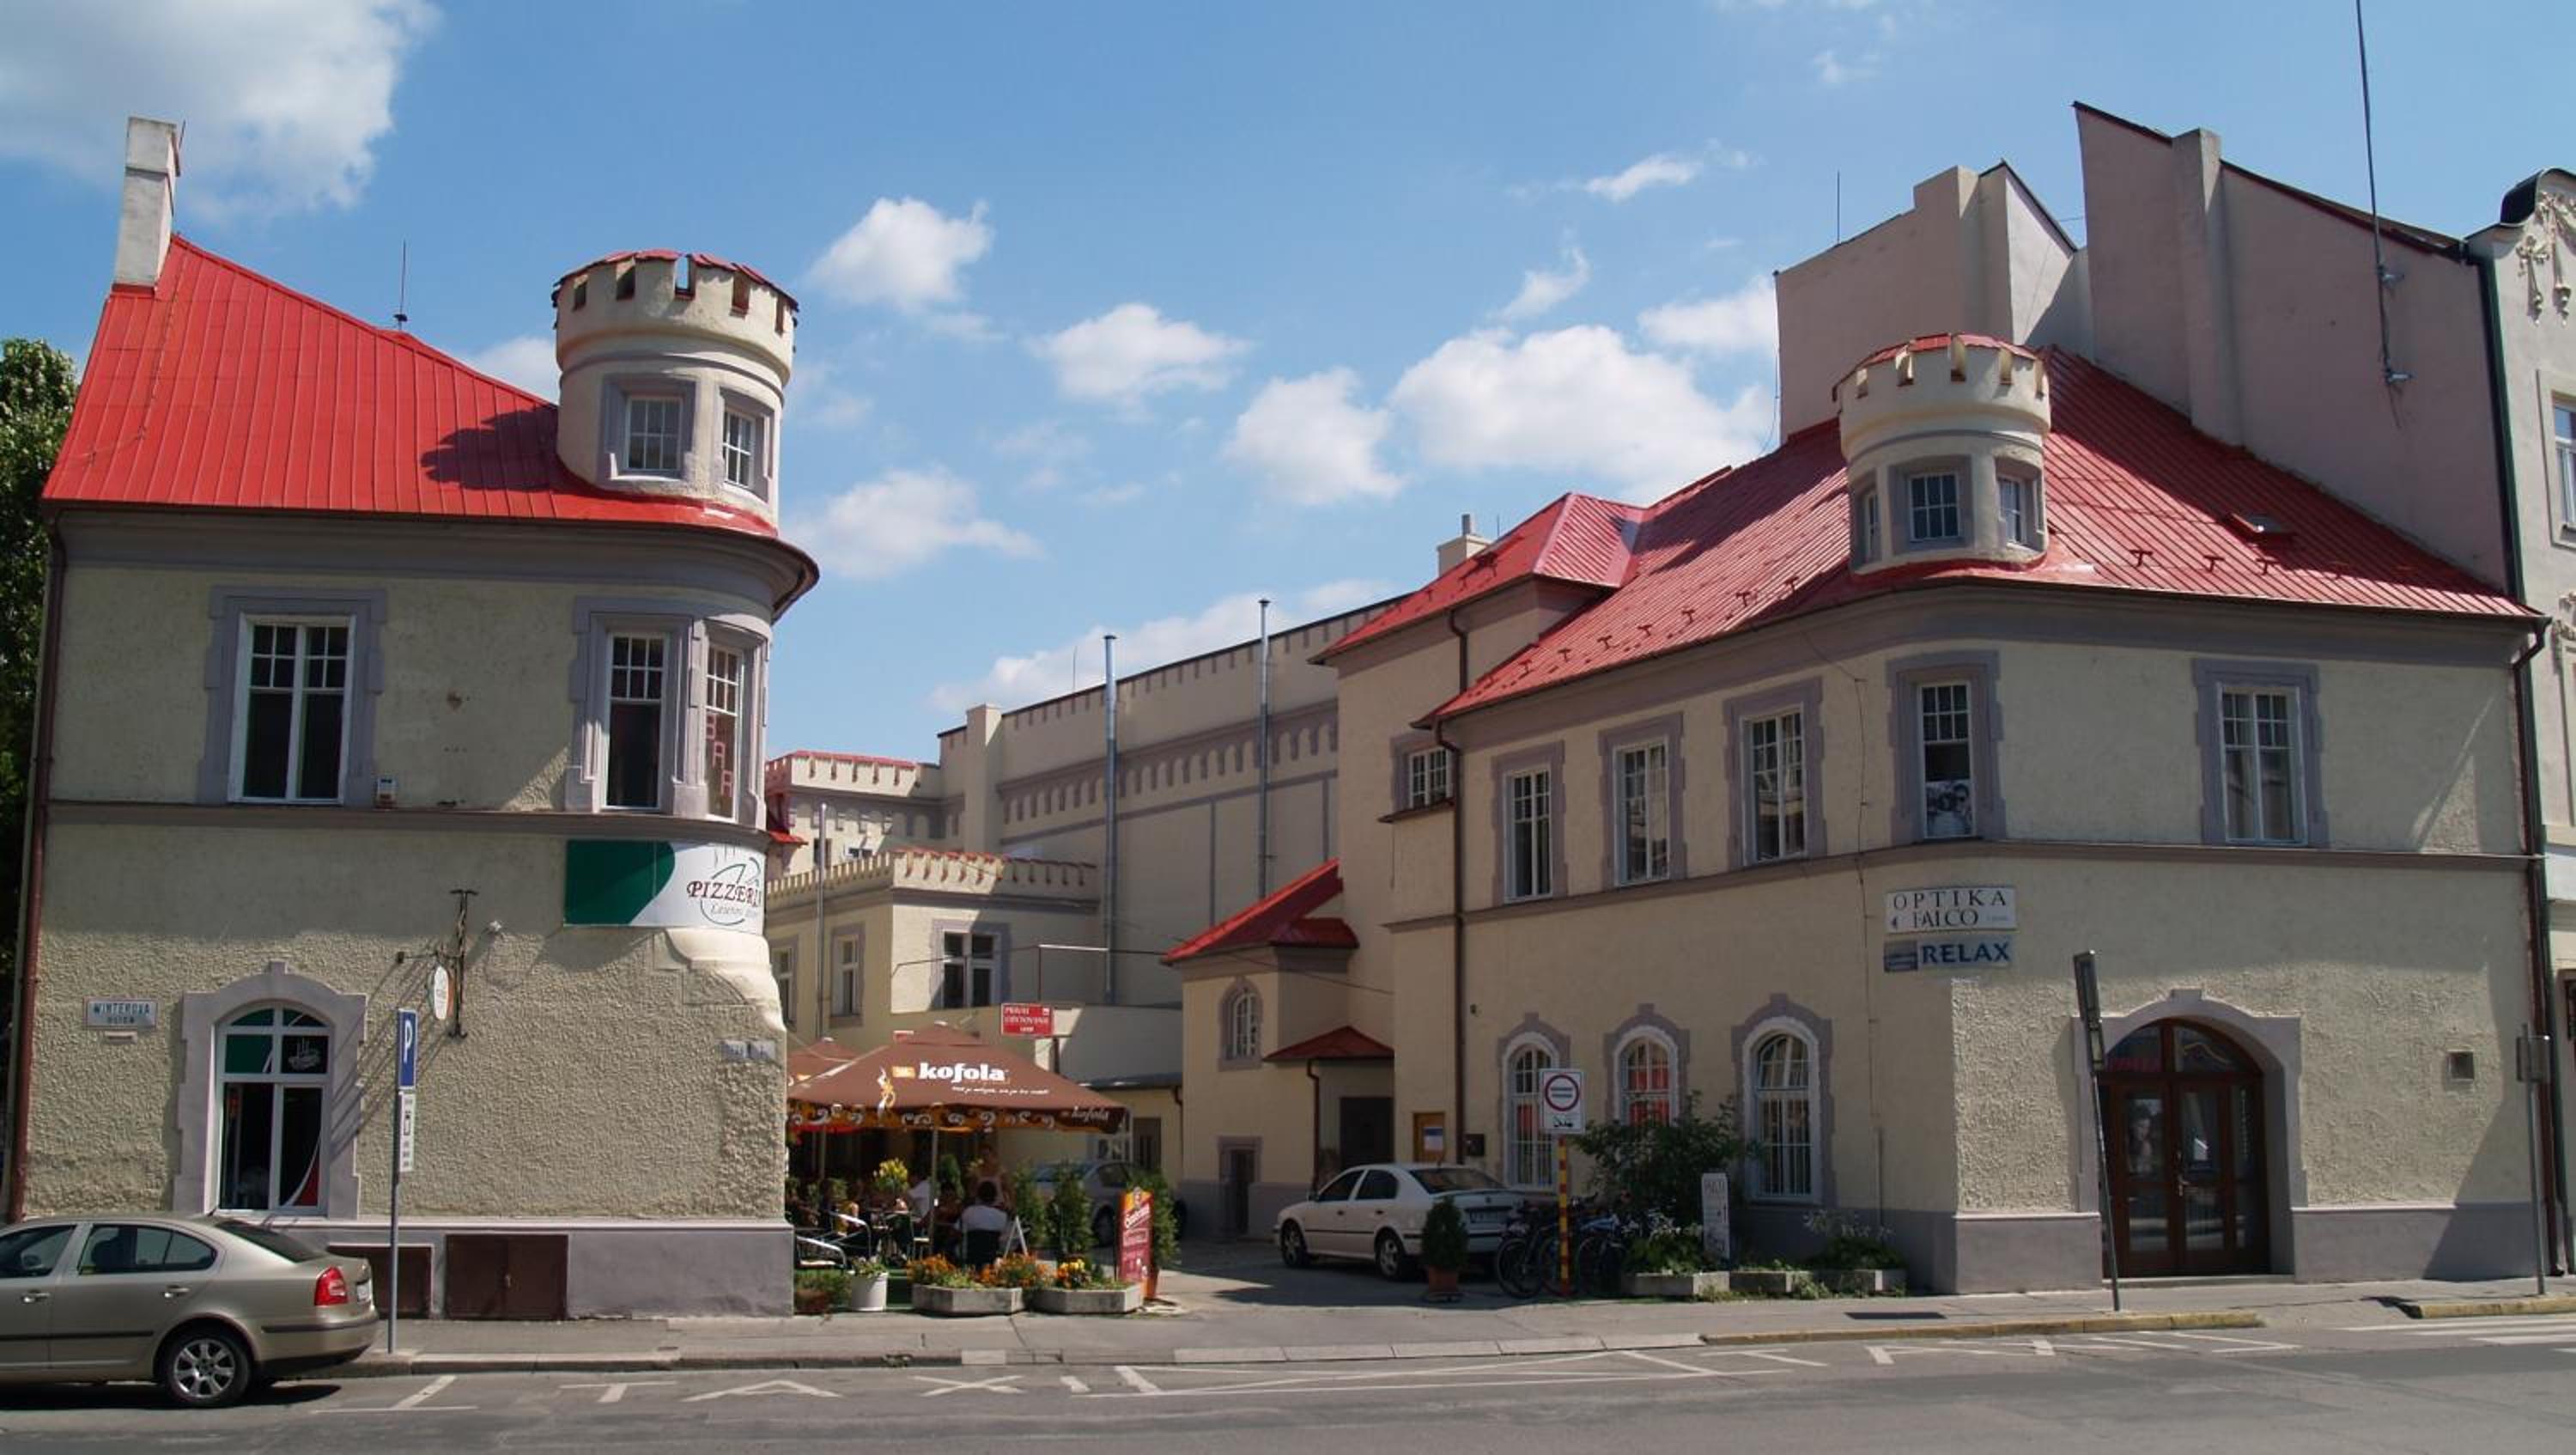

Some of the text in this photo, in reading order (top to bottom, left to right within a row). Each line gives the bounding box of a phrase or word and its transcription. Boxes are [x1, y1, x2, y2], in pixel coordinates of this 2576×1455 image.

[1893, 889, 2007, 910] OPTIKA
[1923, 941, 2010, 964] RELAX
[403, 1020, 413, 1064] P
[918, 1062, 1005, 1083] kofola
